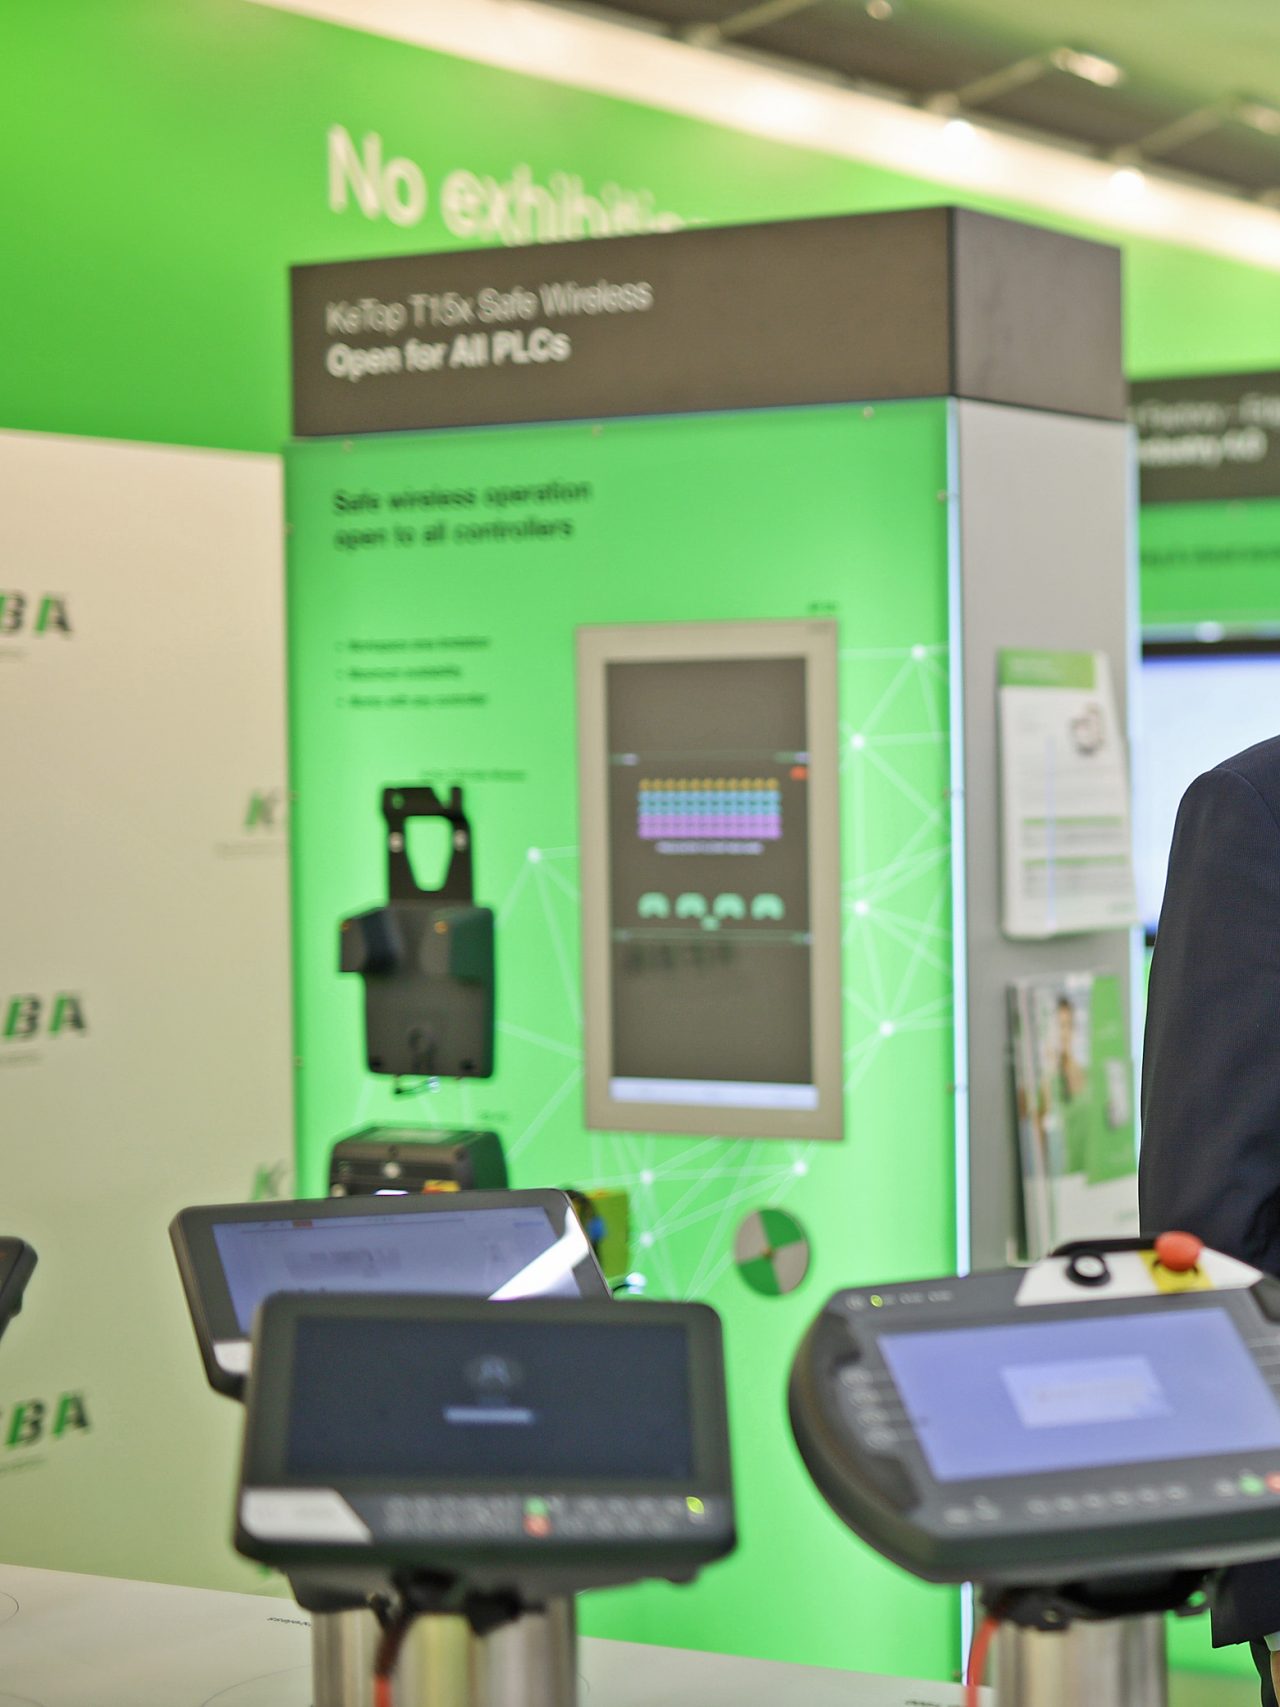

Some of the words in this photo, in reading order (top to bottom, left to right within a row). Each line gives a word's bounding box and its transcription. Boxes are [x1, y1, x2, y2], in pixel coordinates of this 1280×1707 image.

[325, 122, 427, 227] No
[440, 163, 712, 247] exhibiti
[477, 287, 539, 322] Safe
[539, 281, 655, 318] Wireless
[326, 342, 402, 383] Open
[404, 337, 447, 372] for
[449, 333, 489, 368] All
[491, 326, 573, 365] PLCs
[483, 480, 593, 508] operation
[334, 527, 388, 553] open
[393, 524, 415, 547] to
[422, 519, 447, 545] all
[452, 515, 575, 544] controllers
[0, 1392, 91, 1450] BA
